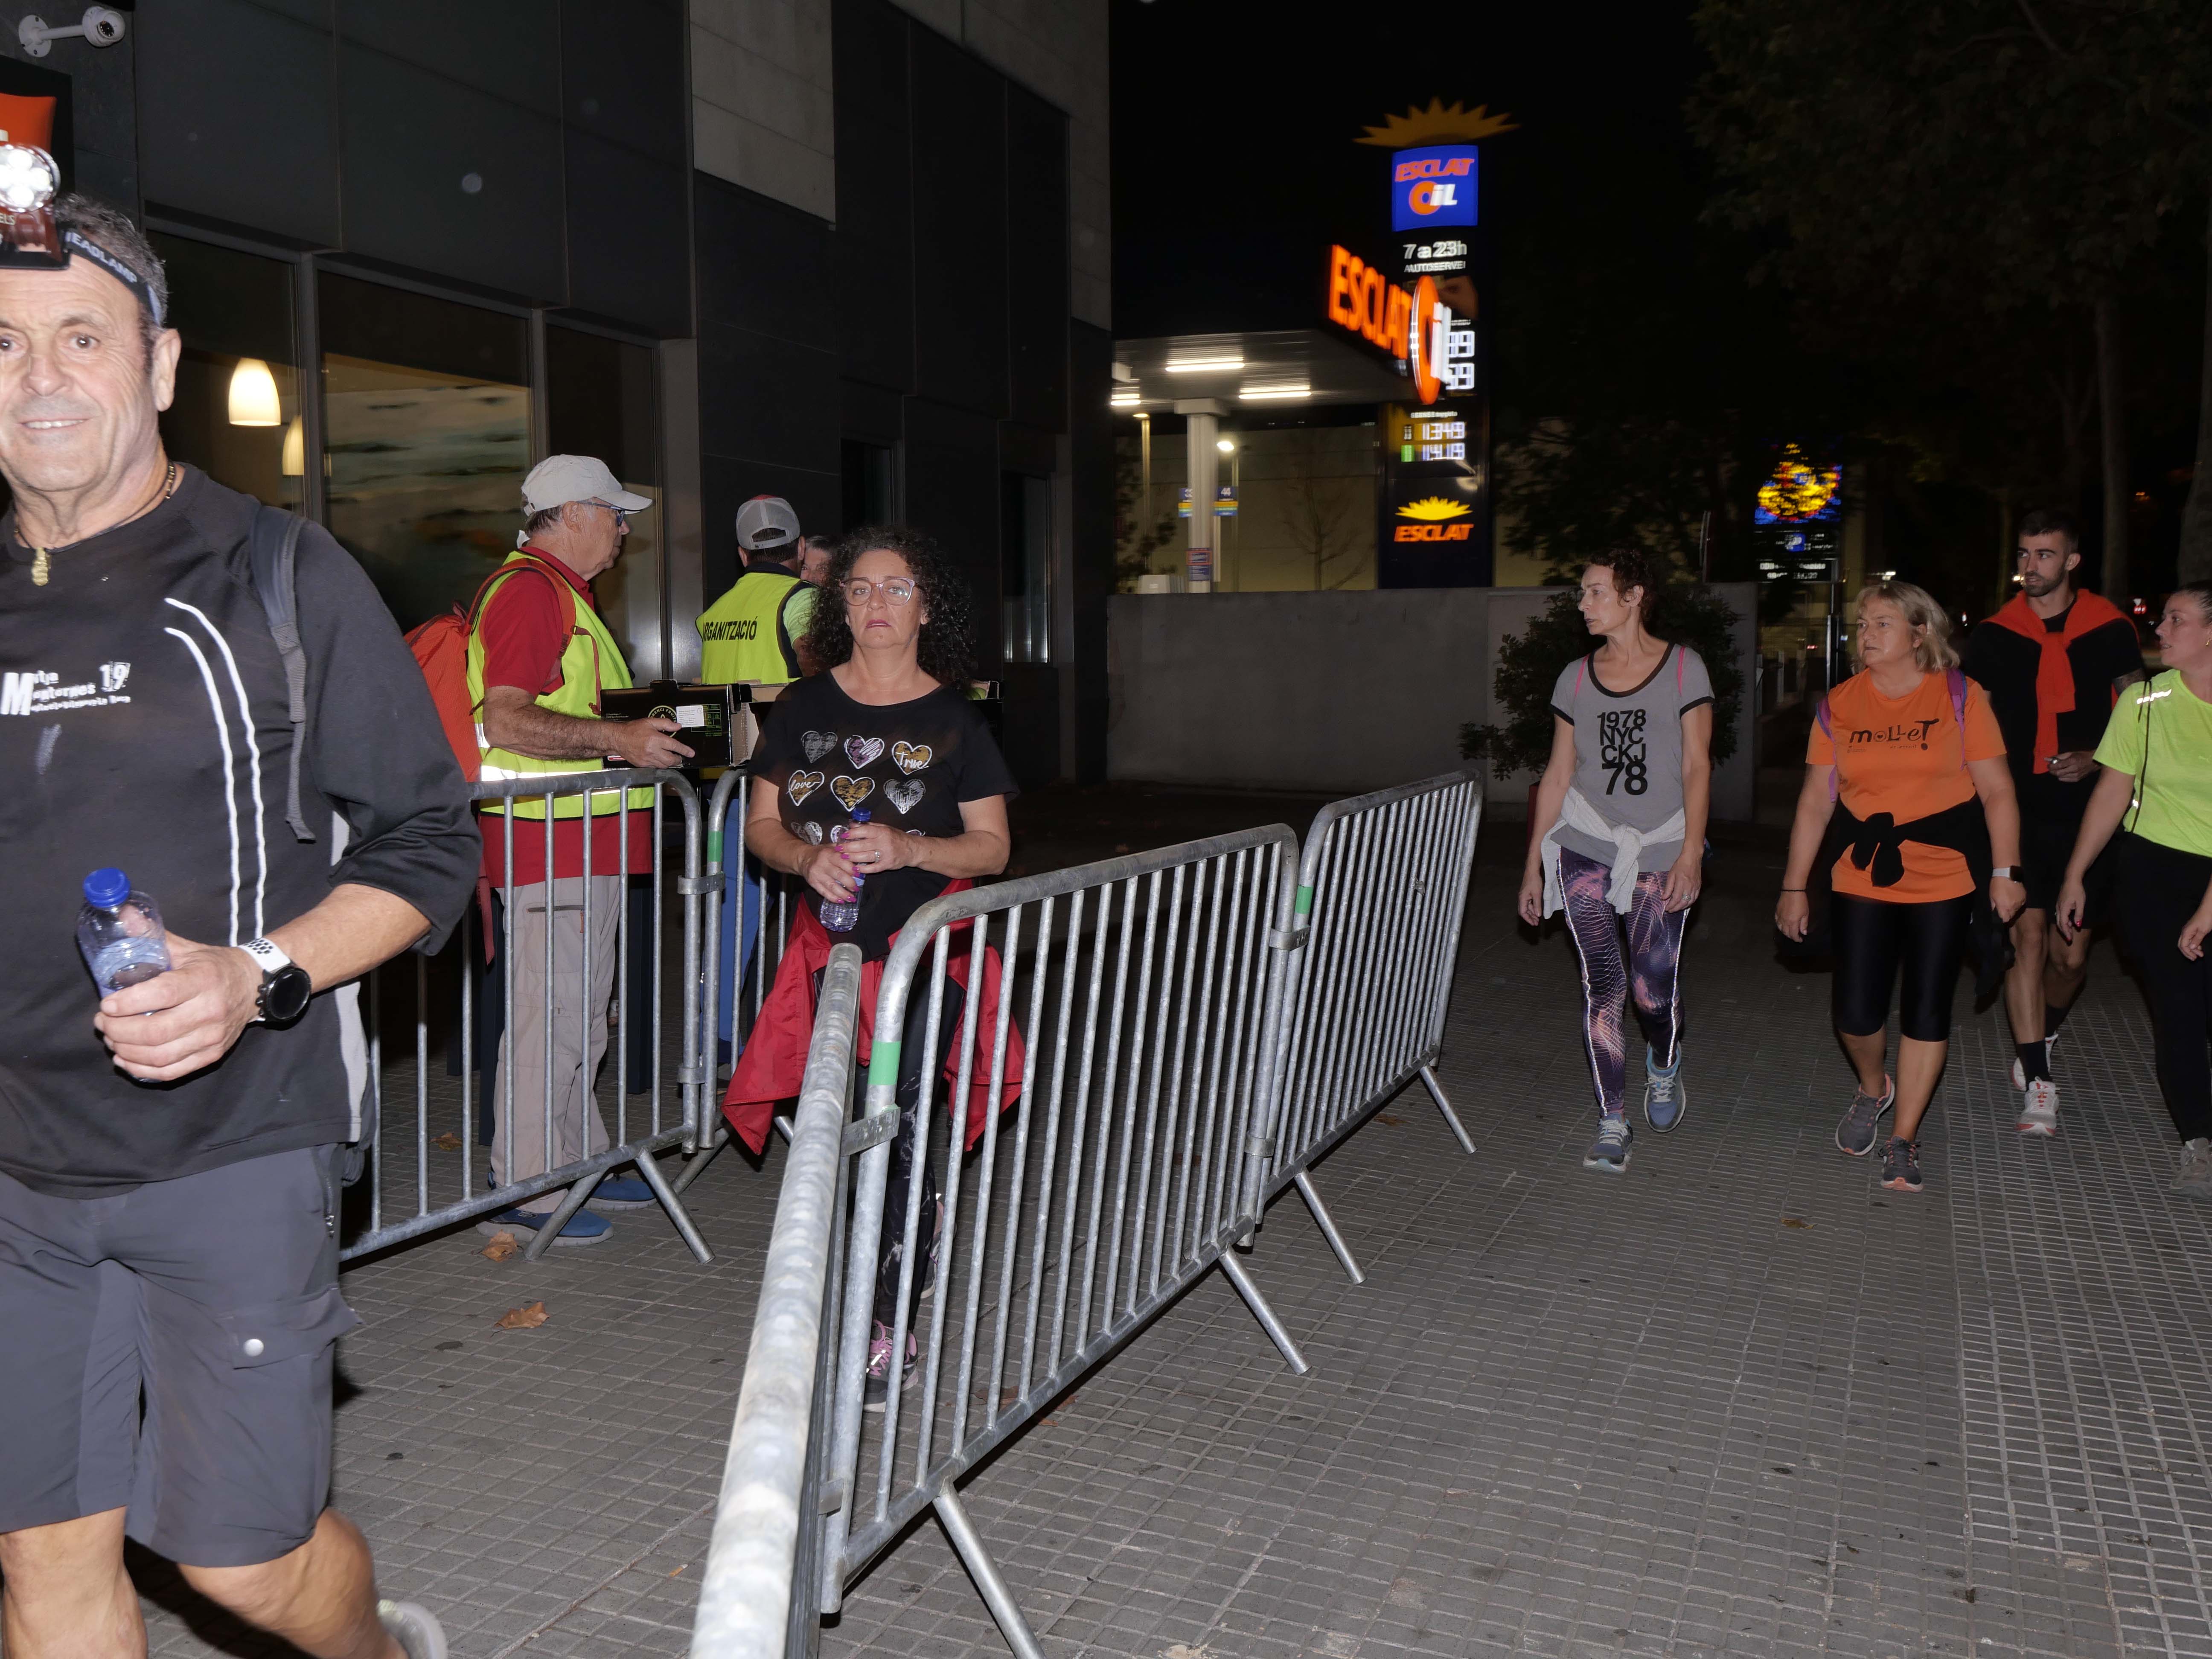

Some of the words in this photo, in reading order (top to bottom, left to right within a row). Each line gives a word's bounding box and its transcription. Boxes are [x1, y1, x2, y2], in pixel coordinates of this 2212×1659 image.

[1394, 158, 1475, 183] ESCLAT
[1403, 244, 1416, 259] 7
[1417, 246, 1432, 259] a
[1432, 240, 1467, 258] 23h
[1404, 260, 1466, 273] AUTOSERVEI
[1328, 244, 1413, 360] ESCLAT
[1394, 523, 1474, 542] ESCLAT
[1596, 708, 1647, 729] 1978
[1599, 726, 1644, 746] NYC
[895, 751, 930, 769] True
[1601, 744, 1647, 764] CKJ
[1602, 762, 1648, 795] 78
